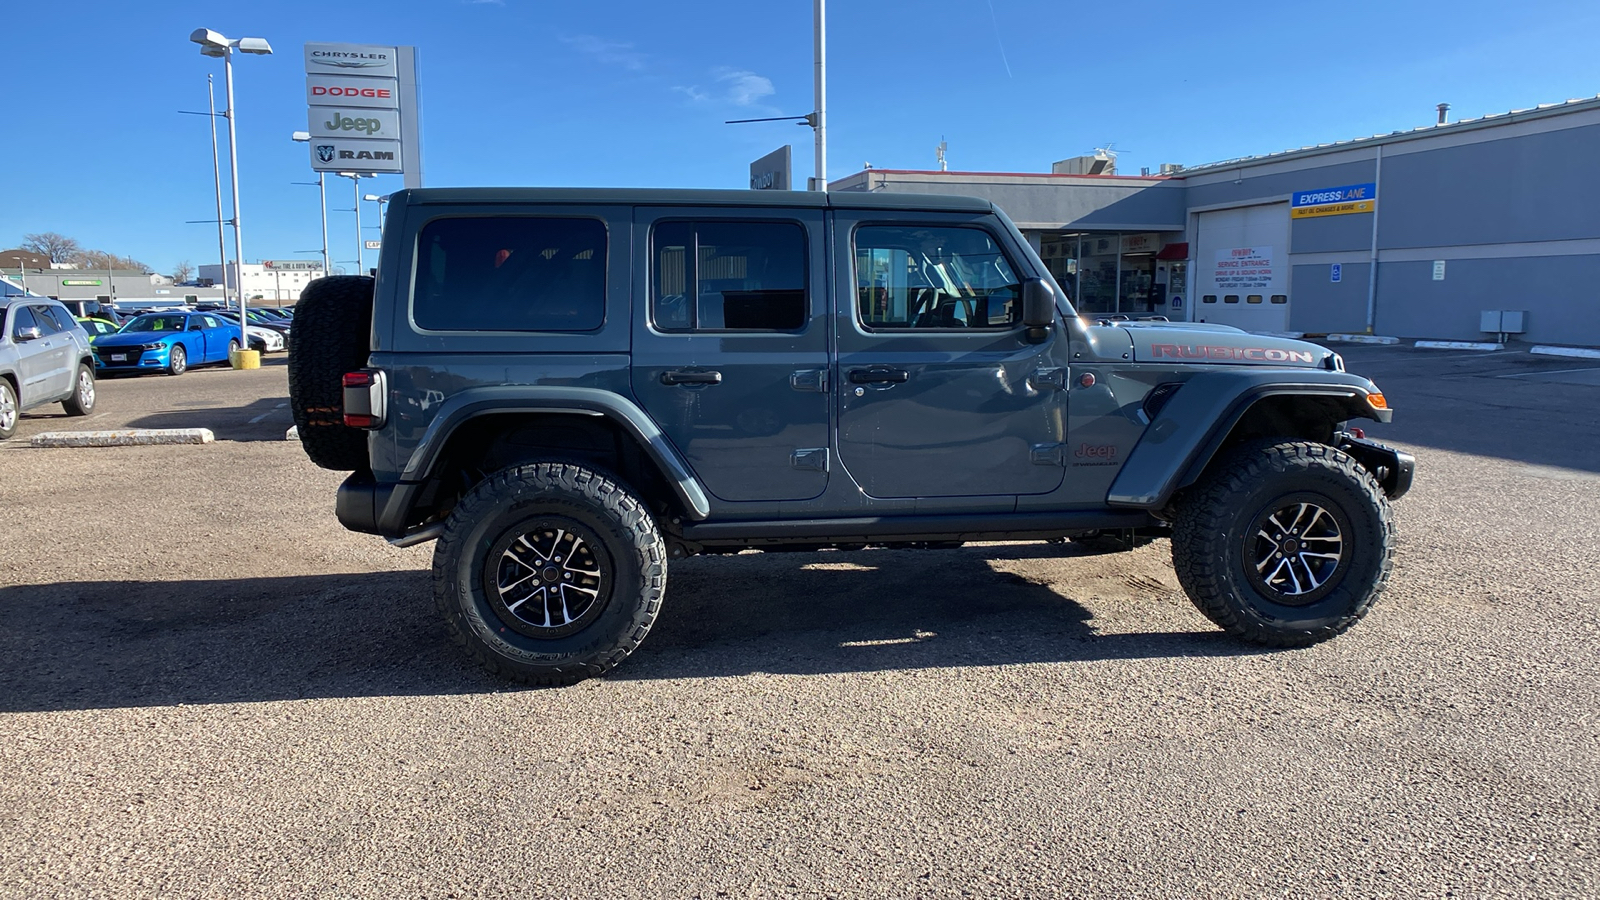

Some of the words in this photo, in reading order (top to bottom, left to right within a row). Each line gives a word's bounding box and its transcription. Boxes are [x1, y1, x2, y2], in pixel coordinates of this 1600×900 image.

[311, 51, 386, 60] CHRYSLER
[312, 86, 391, 98] DODGE
[325, 112, 381, 135] Jeep
[338, 150, 394, 160] RAM
[1241, 259, 1270, 267] ENTRANCE
[1152, 344, 1313, 363] RUBICON
[1075, 443, 1117, 461] Jeep
